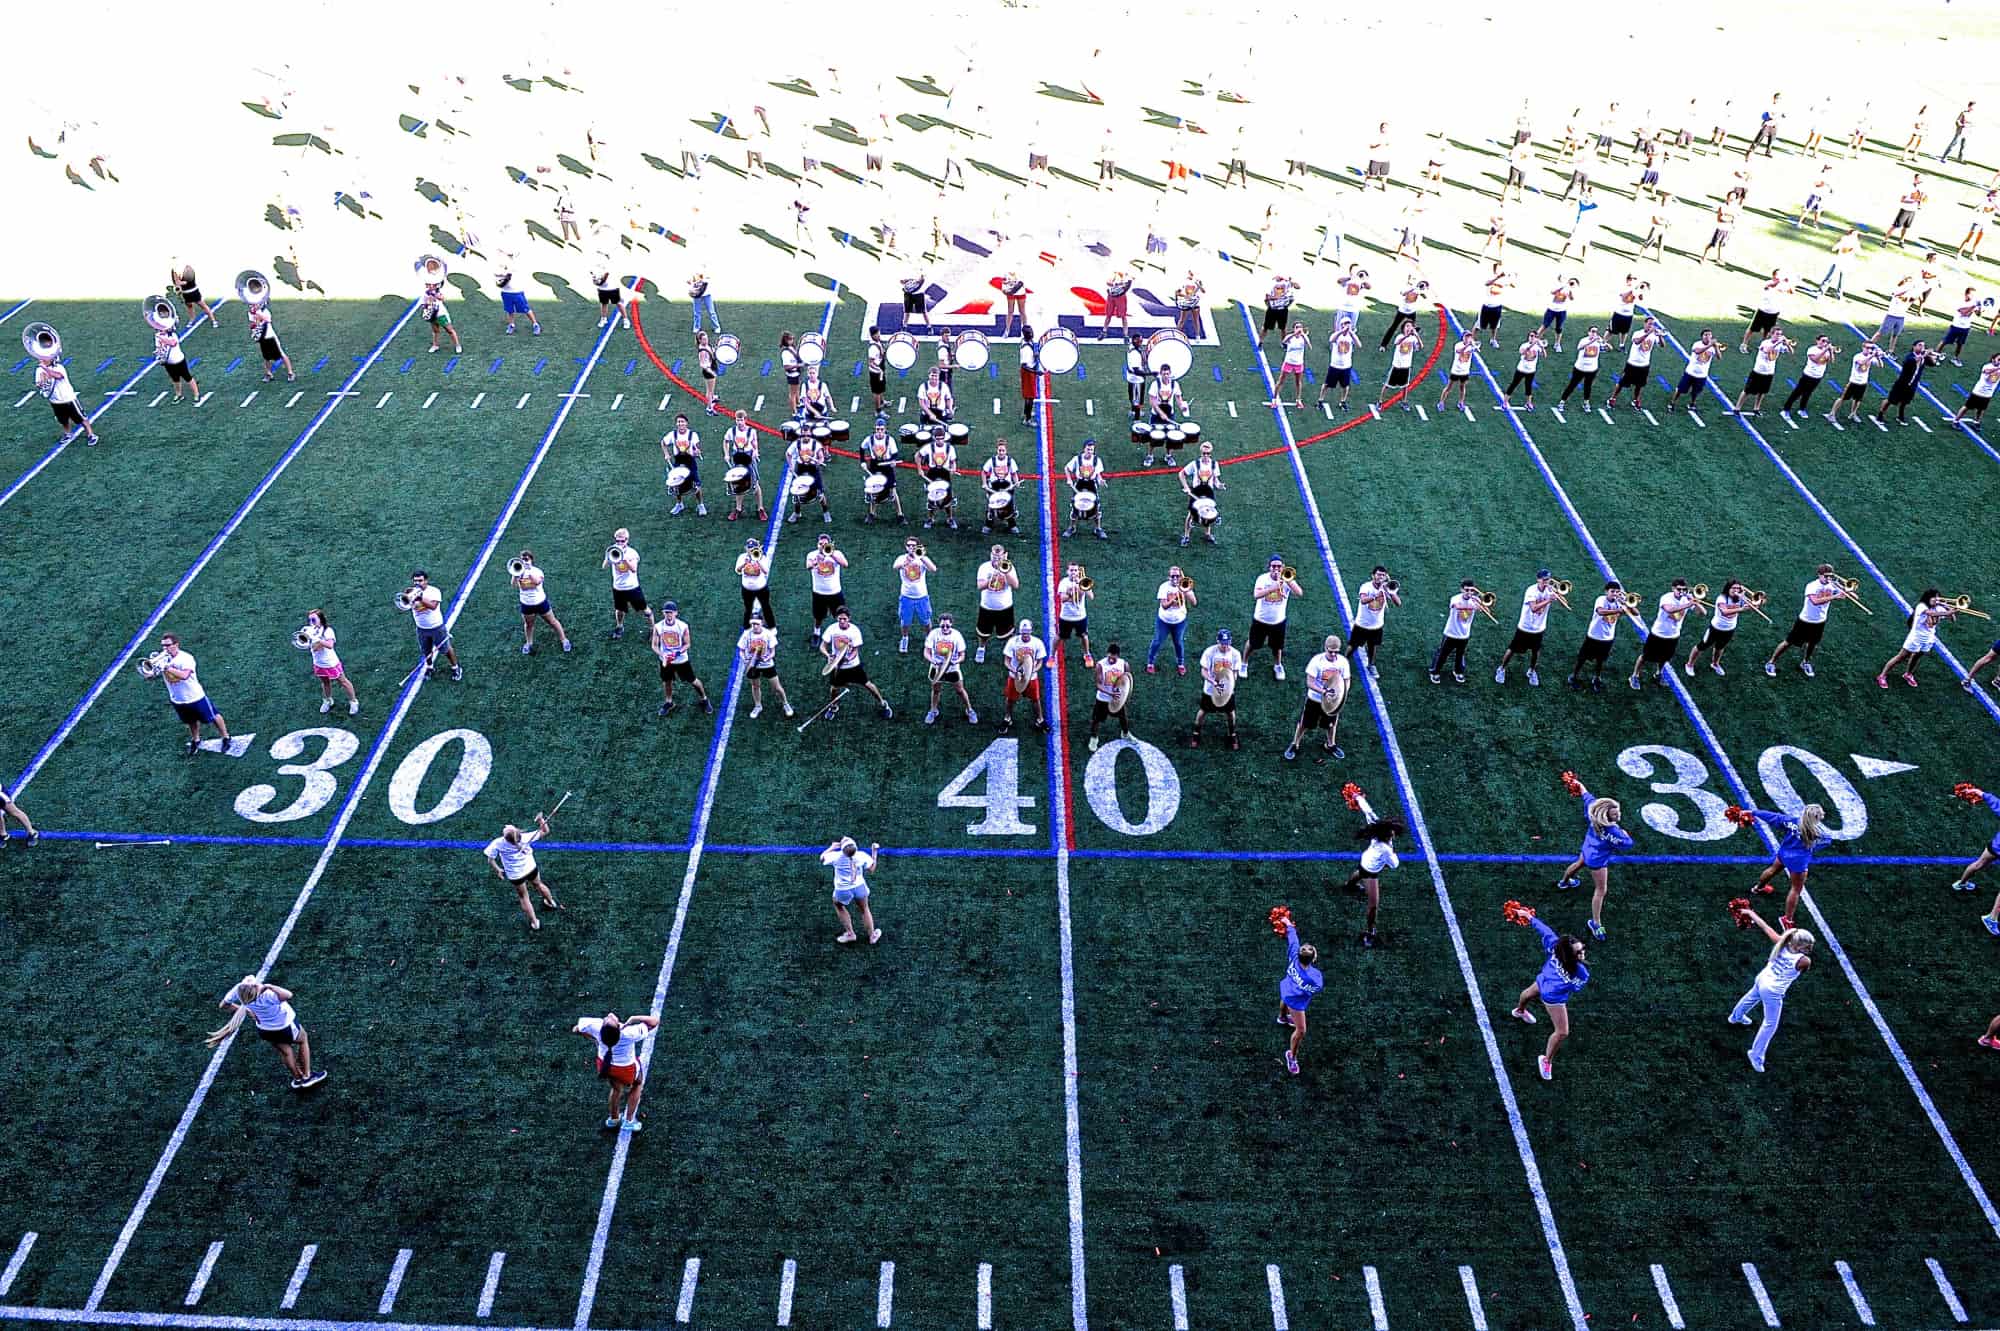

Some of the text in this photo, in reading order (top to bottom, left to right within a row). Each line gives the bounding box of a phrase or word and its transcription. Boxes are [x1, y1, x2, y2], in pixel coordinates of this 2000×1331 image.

[234, 727, 493, 825] 30
[937, 738, 1181, 836] 40
[1616, 745, 1868, 841] 30
